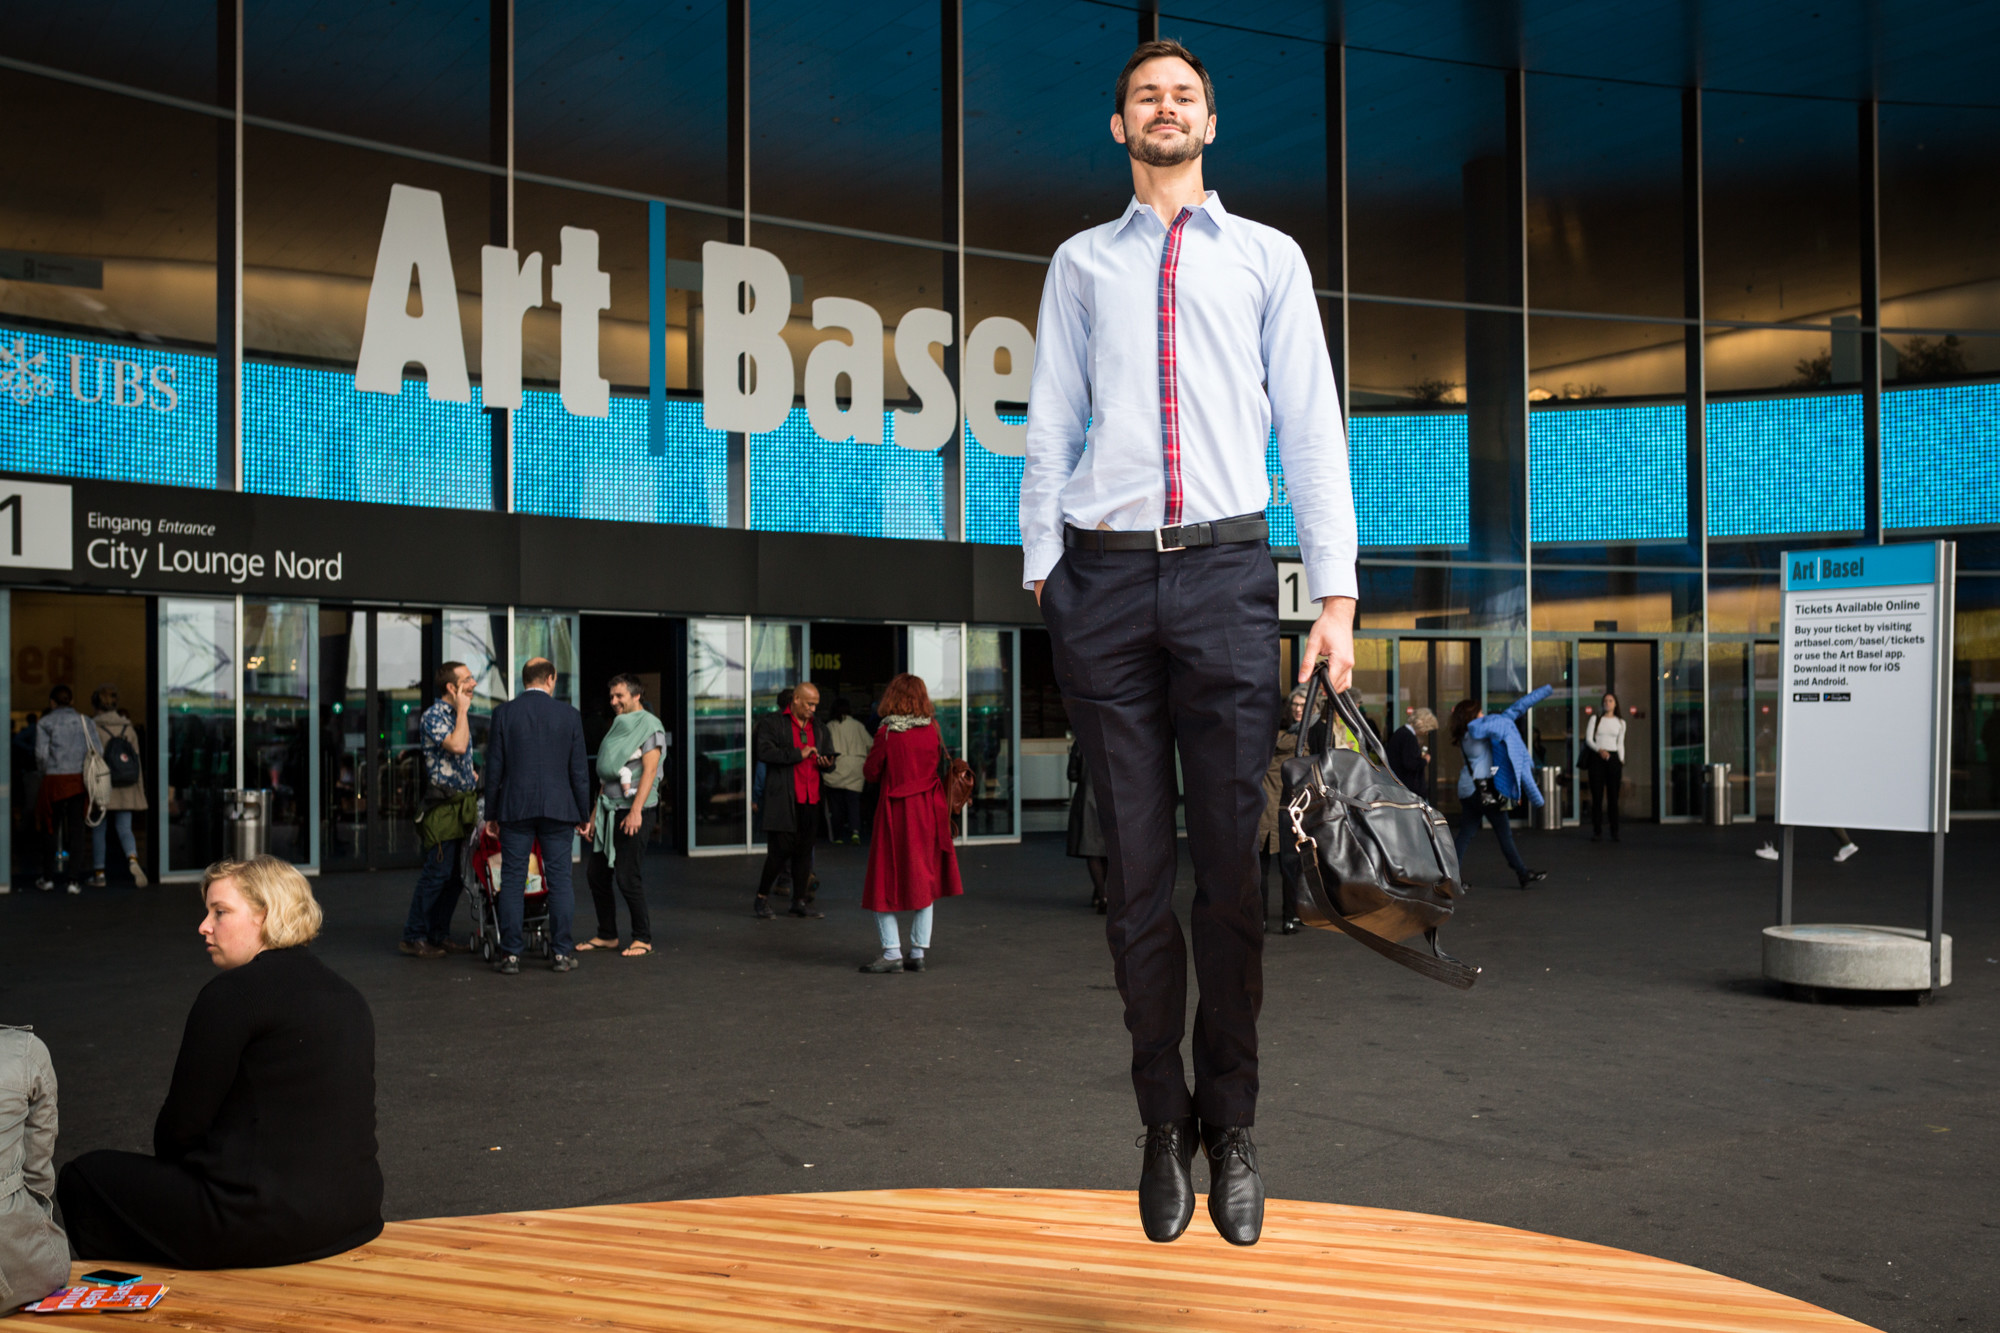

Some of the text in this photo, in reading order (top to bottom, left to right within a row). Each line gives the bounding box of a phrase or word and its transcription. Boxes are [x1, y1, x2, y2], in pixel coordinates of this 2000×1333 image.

[354, 183, 1035, 456] Art Base
[67, 353, 178, 412] UBS
[0, 494, 22, 556] 1
[88, 512, 216, 536] Eingang Entrance
[87, 538, 342, 583] City Lounge Nord
[1792, 557, 1864, 581] Art Basel
[1284, 572, 1299, 613] 1
[1795, 600, 1920, 615] Tickets Available Online
[1795, 622, 1911, 635] Buy your ticket by visiting
[1794, 635, 1925, 647] artbasel.com/basel/tickets
[17, 636, 75, 684] ed
[810, 649, 841, 670] ions
[1823, 651, 1837, 659] the
[1840, 650, 1854, 659] Art
[1857, 650, 1882, 658] Basel
[1885, 651, 1905, 661] app.
[1794, 664, 1837, 673] Download
[1840, 663, 1845, 672] it
[1870, 663, 1881, 671] for
[1884, 663, 1900, 671] iOS
[1793, 677, 1848, 686] and Android.
